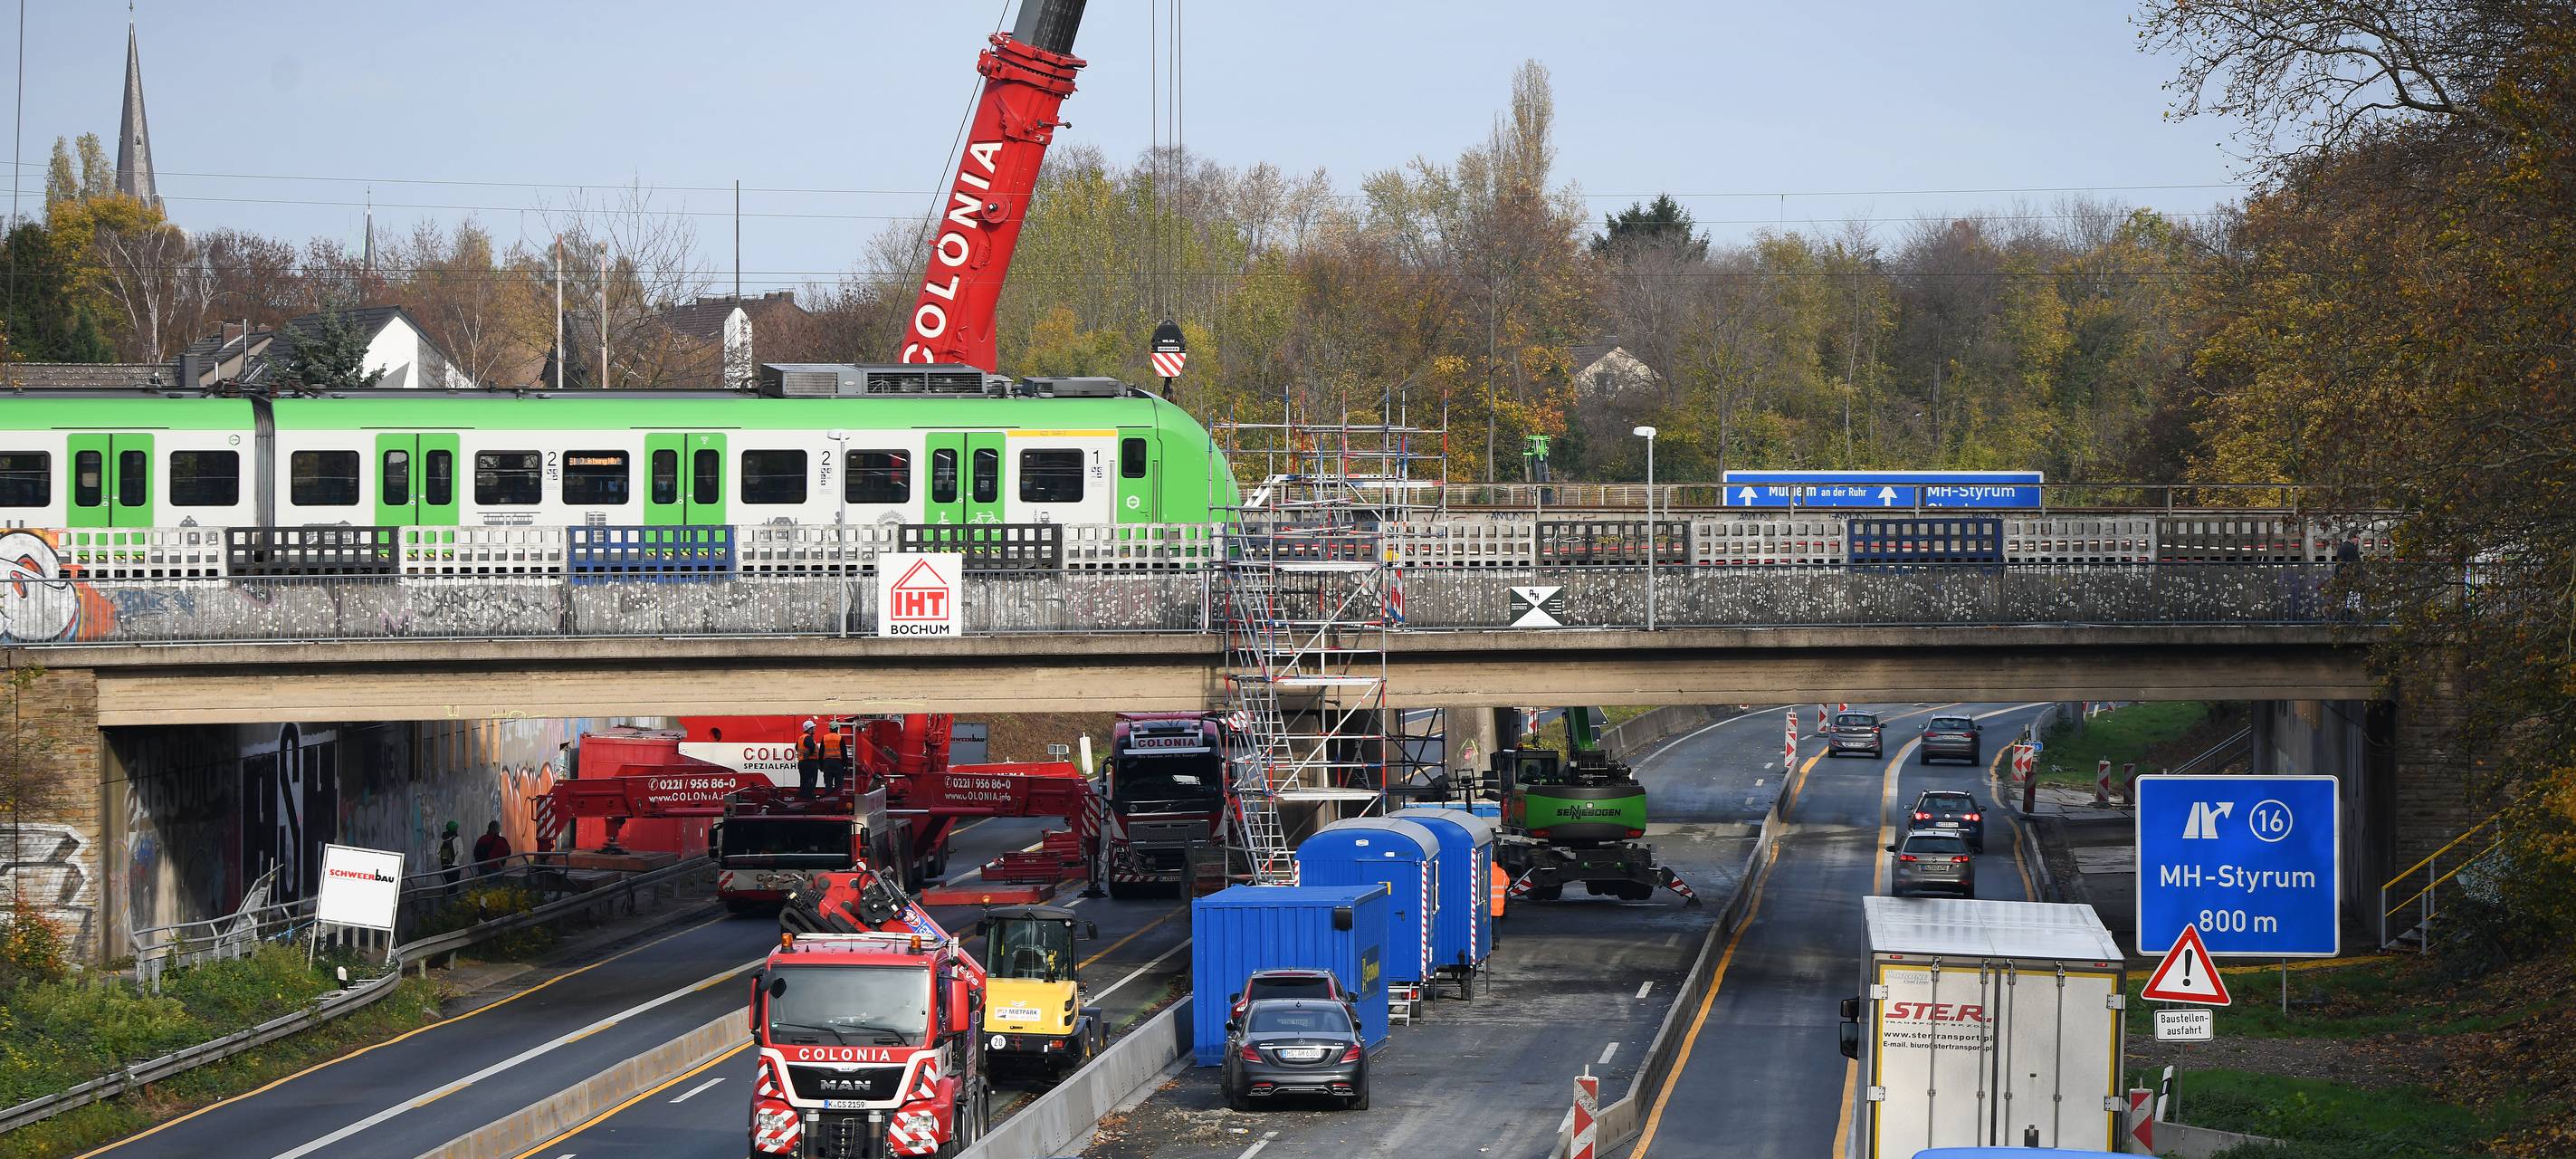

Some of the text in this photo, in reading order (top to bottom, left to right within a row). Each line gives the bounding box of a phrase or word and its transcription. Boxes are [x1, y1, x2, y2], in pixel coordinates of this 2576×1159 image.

[903, 140, 1002, 363] COLONIA
[548, 451, 557, 466] 2
[822, 450, 831, 465] 2
[1092, 449, 1099, 465] 1
[1769, 486, 1817, 497] Mlem
[1833, 487, 1846, 497] der
[1848, 487, 1867, 497] Ruhr
[1927, 486, 2016, 500] MH-Styrum
[894, 591, 944, 617] IHT
[891, 624, 949, 635] BOCHUM
[1138, 738, 1196, 748] COLONIA
[743, 747, 797, 761] COLO
[660, 779, 683, 790] 0221
[690, 779, 709, 789] 956
[711, 778, 736, 789] 86-0
[953, 778, 970, 789] 0221
[976, 779, 990, 789] 956
[991, 780, 1011, 790] 86-0
[1556, 805, 1622, 820] SENNEBOGEN
[2258, 809, 2284, 832] 16
[2160, 865, 2315, 894] MH-Styrum
[2199, 909, 2277, 933] 800 m
[2161, 1013, 2209, 1023] Baustellen-
[2167, 1025, 2201, 1035] ausfahrt
[994, 1038, 1003, 1047] 20
[1884, 1032, 1993, 1042] www.sterransportpl
[1910, 1042, 1993, 1052] biurostertranspor.pl
[798, 1048, 891, 1061] COLONIA
[820, 1079, 872, 1090] MAN
